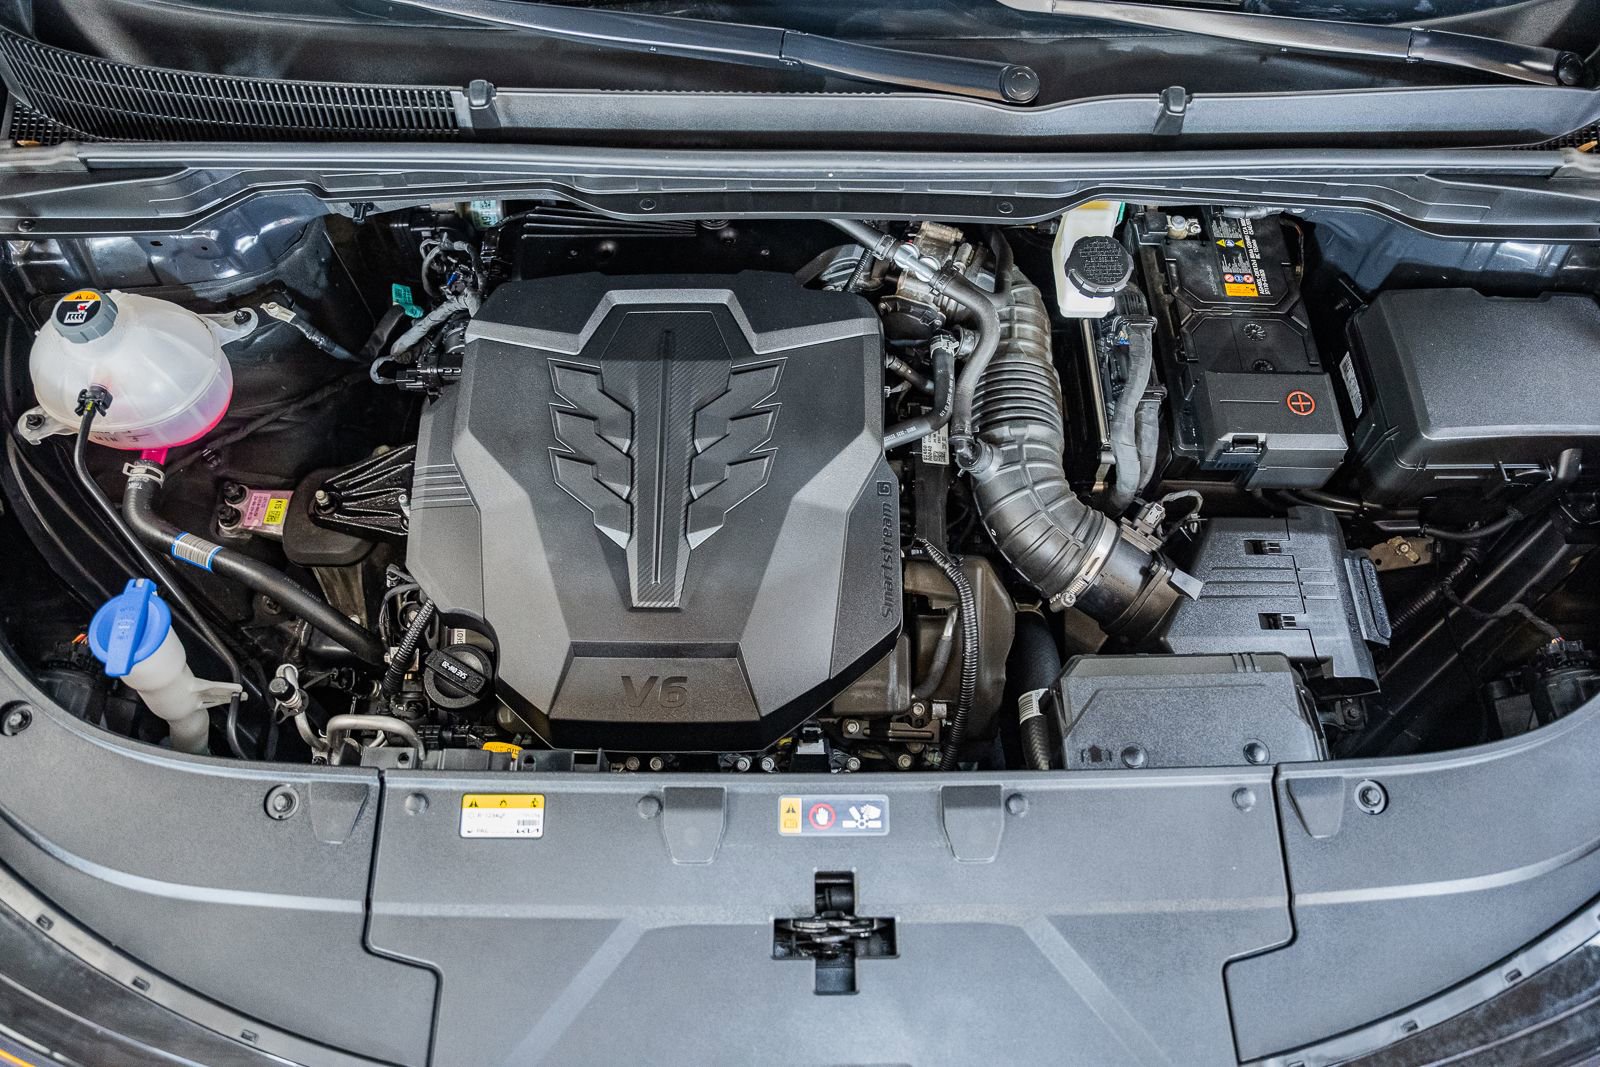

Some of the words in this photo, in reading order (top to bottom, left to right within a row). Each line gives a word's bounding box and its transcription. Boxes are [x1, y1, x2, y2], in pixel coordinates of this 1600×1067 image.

[879, 502, 893, 620] Smartstream
[441, 660, 458, 675] 0W-20
[456, 669, 468, 680] SAE
[620, 675, 688, 708] V6
